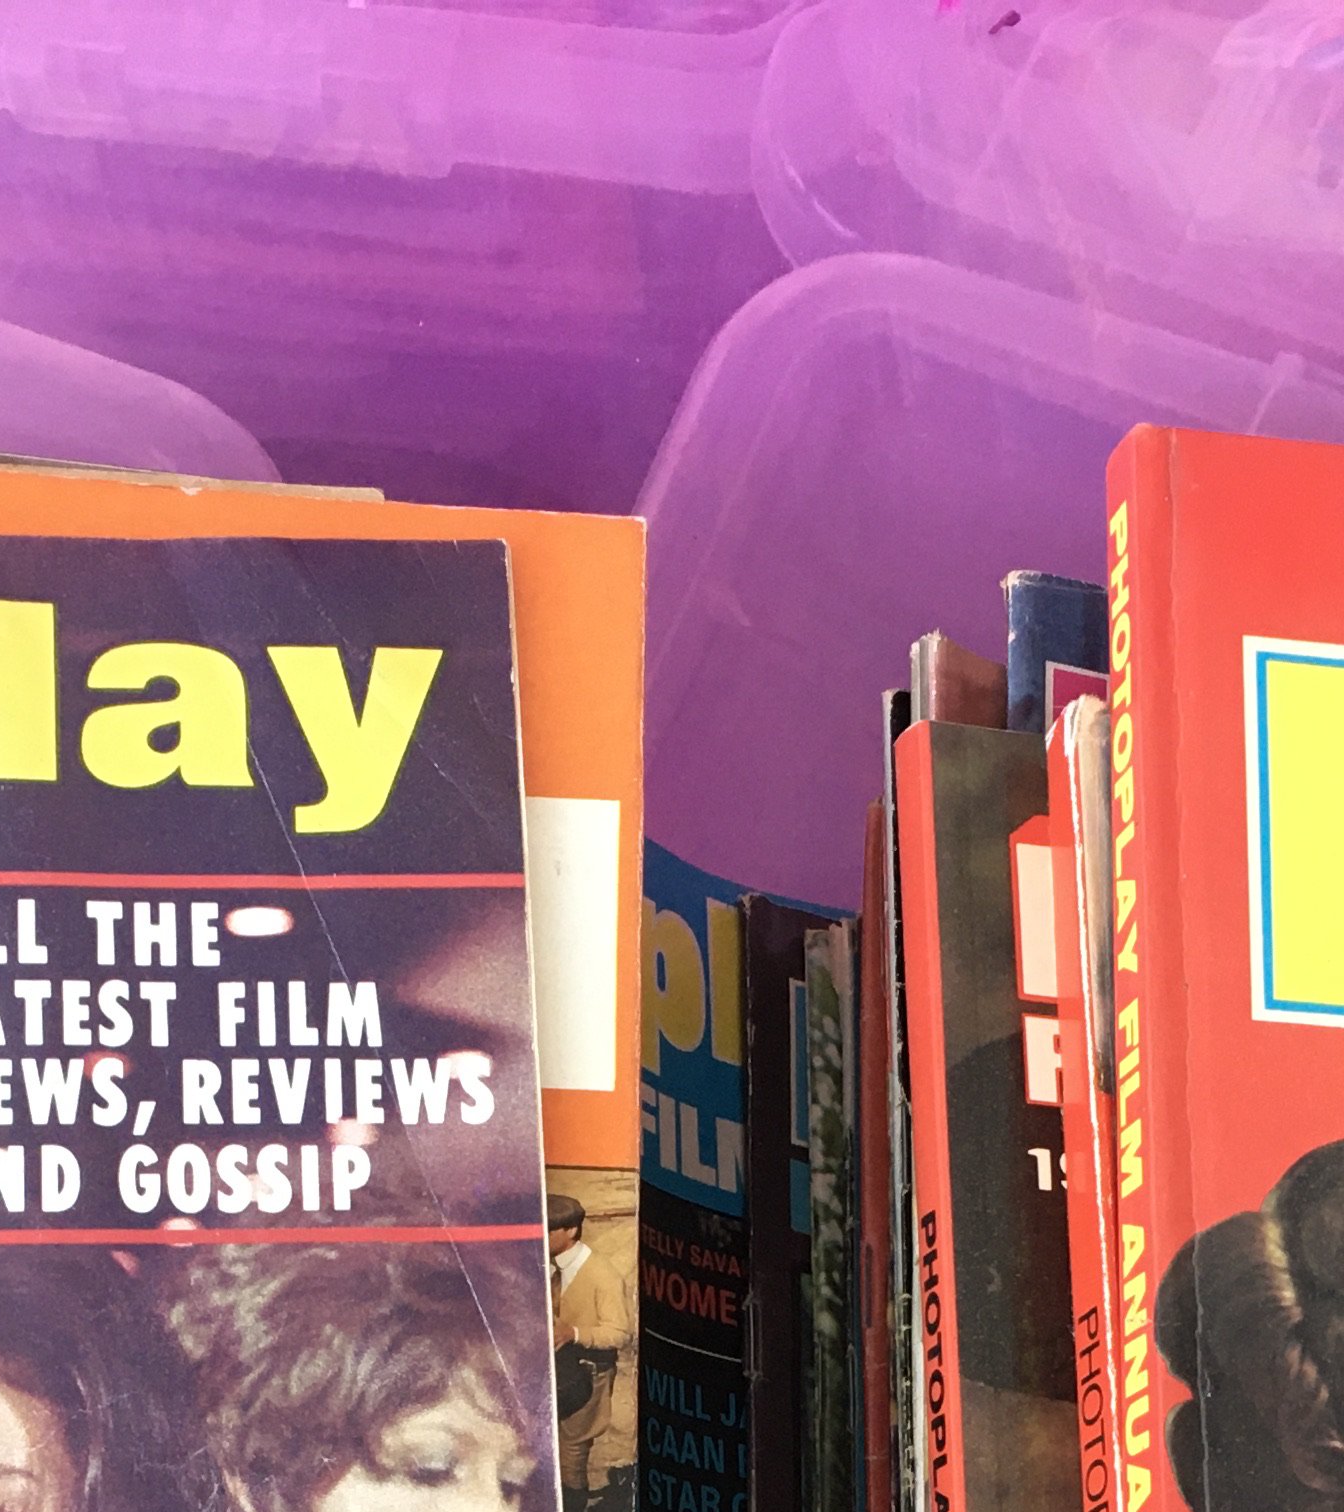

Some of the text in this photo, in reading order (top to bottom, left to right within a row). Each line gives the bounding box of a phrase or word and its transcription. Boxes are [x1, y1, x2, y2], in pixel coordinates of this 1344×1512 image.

[1109, 500, 1139, 974] PHOTOPLAY
[86, 899, 223, 967] THE
[217, 980, 383, 1049] FILM
[181, 1055, 496, 1127] REVIEWS
[1118, 998, 1143, 1199] FILM
[117, 1143, 373, 1214] GOSSIP
[644, 1364, 712, 1423] WILL
[646, 1416, 725, 1475] CAAN
